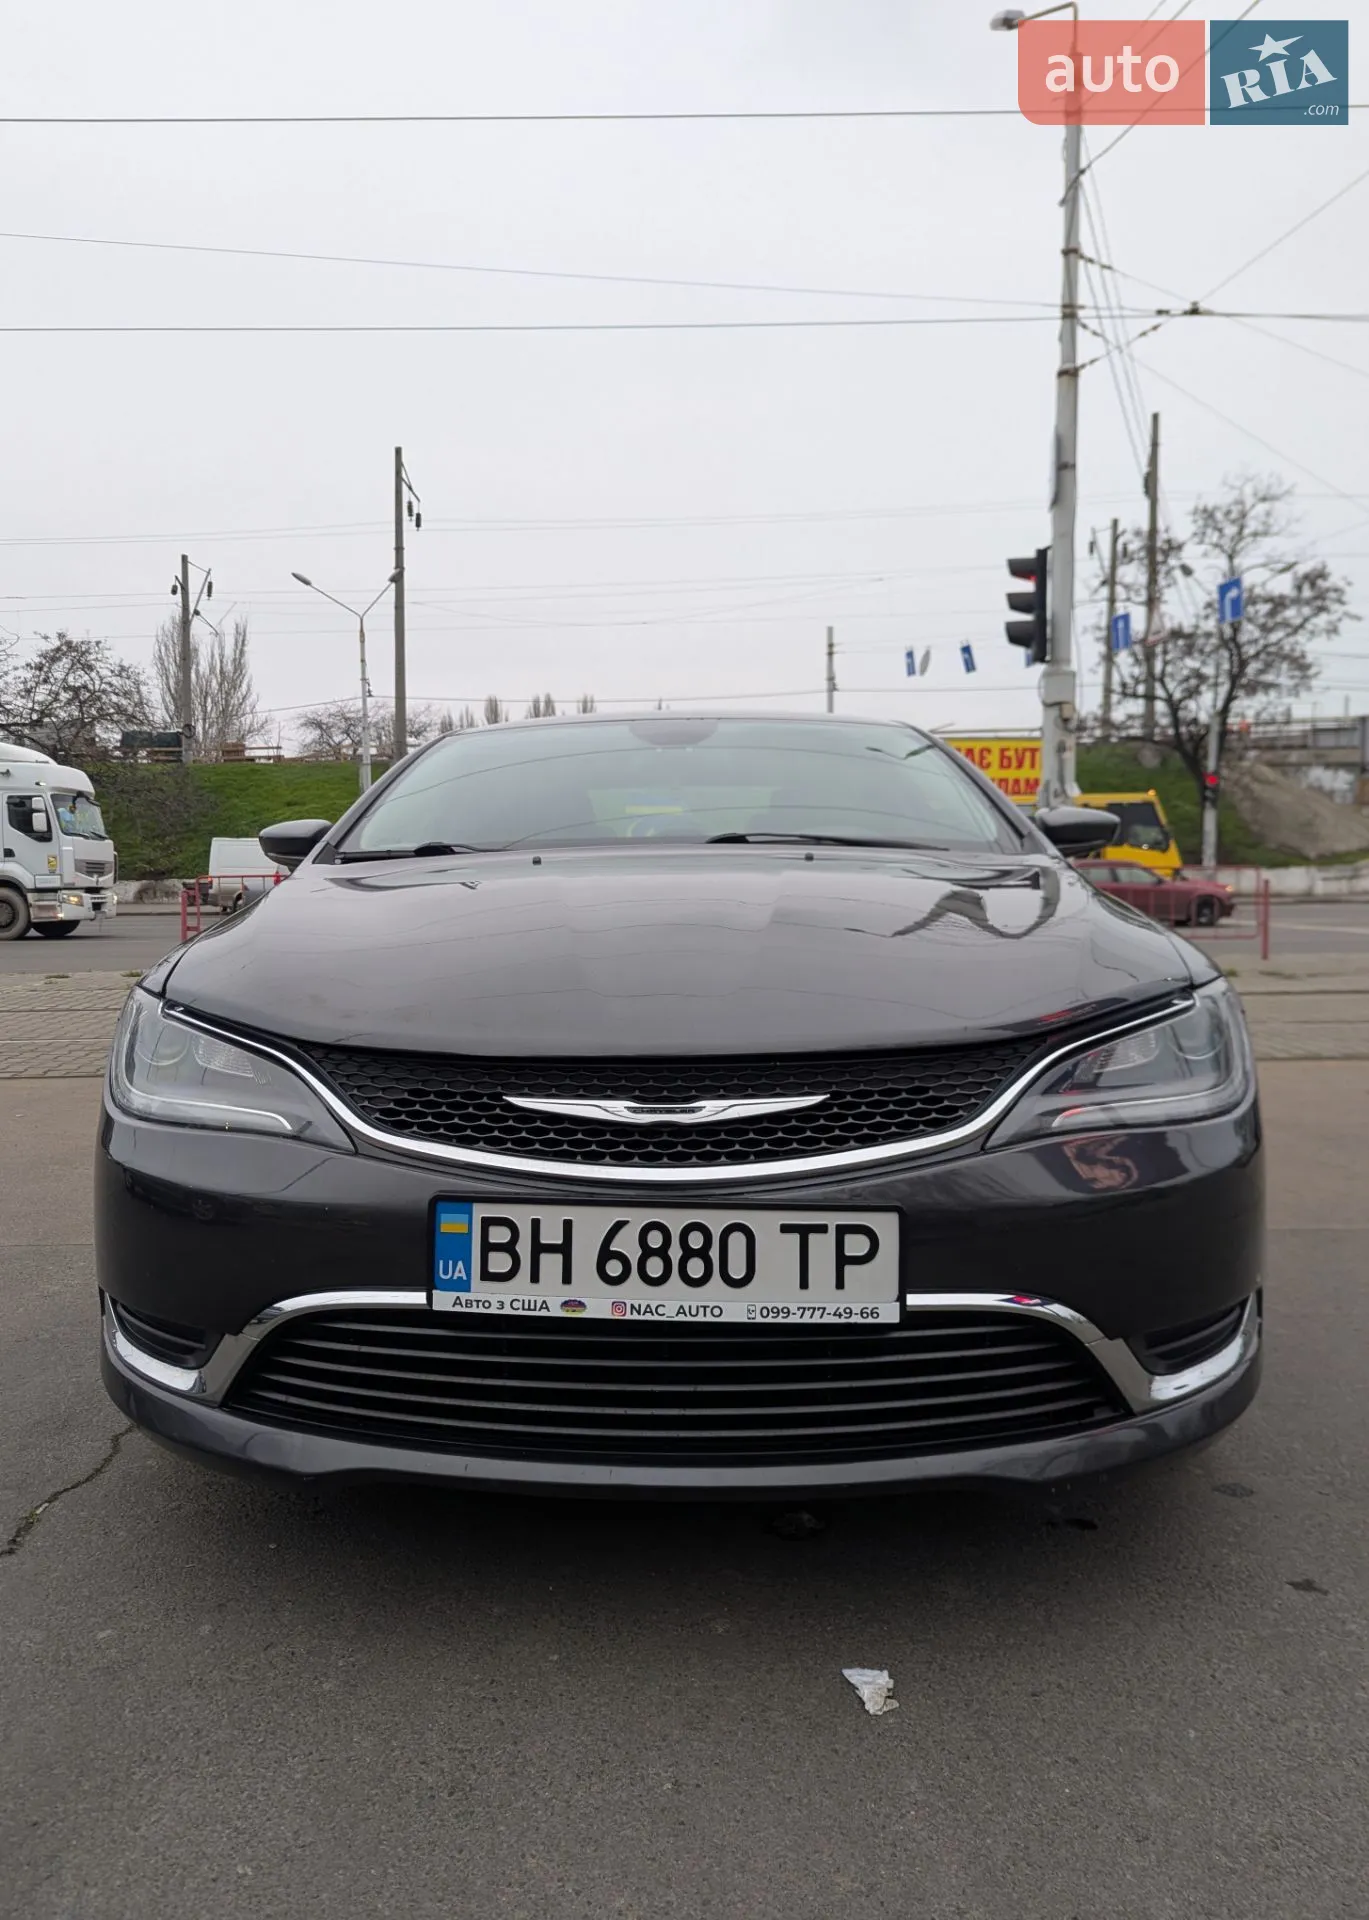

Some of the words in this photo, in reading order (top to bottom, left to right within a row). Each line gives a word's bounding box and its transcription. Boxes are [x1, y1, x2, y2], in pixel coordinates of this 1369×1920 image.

[955, 747, 991, 769] АЄ
[596, 1219, 756, 1289] 6880
[438, 1260, 468, 1281] UA
[452, 1296, 492, 1310] Авто
[509, 1299, 551, 1313] США
[629, 1303, 724, 1319] NAC_AUTO
[759, 1306, 880, 1320] 099-777-49-66
